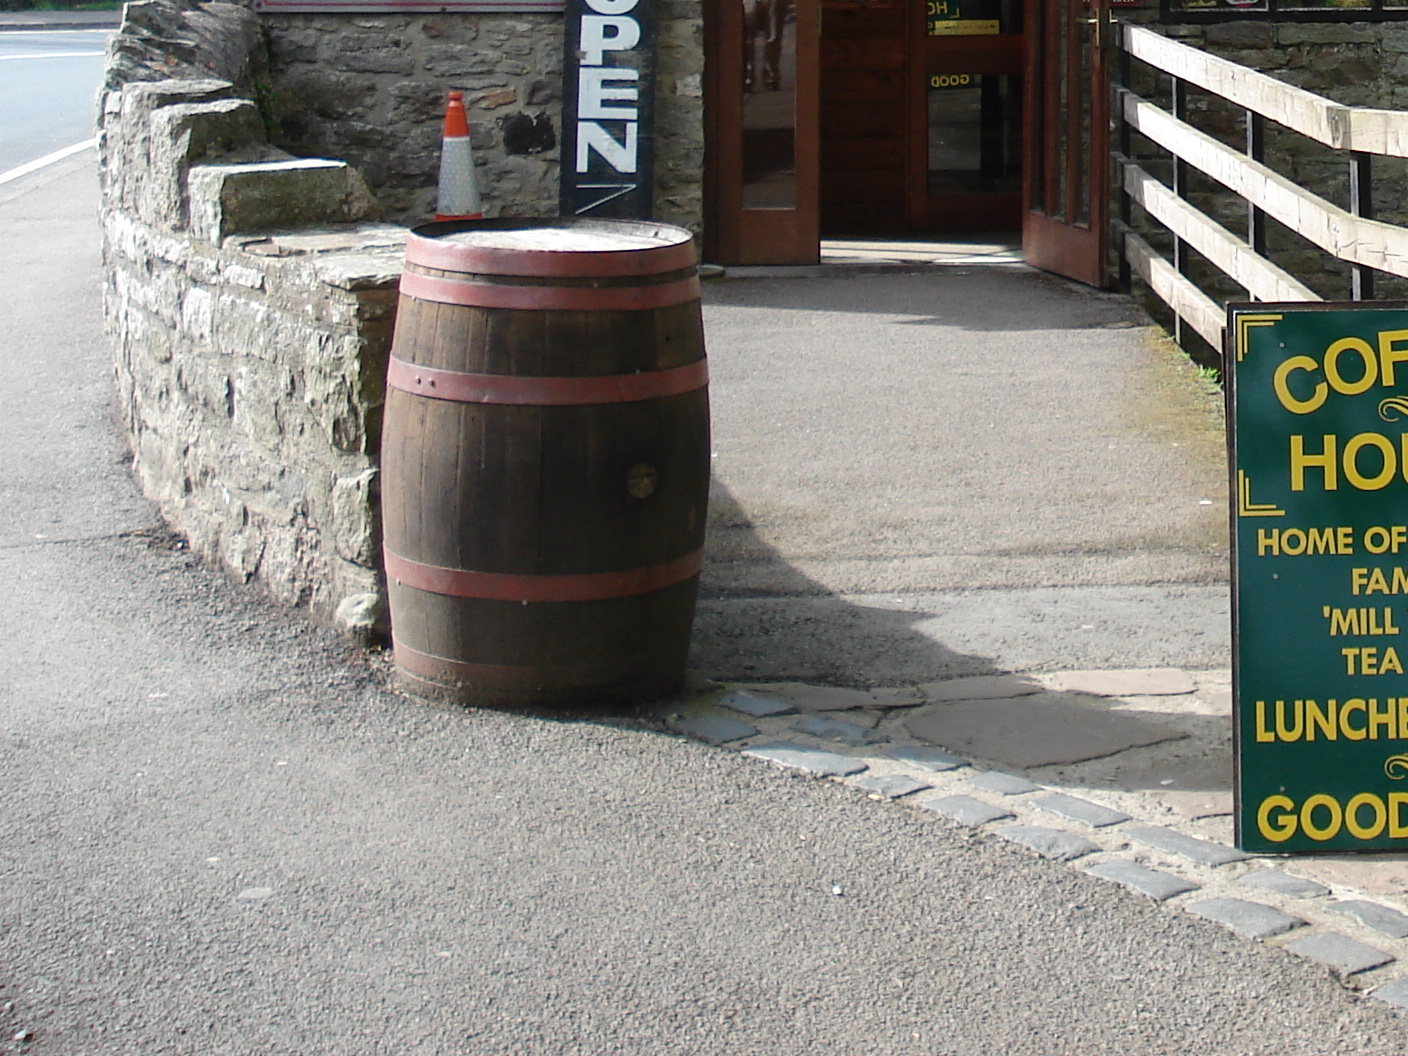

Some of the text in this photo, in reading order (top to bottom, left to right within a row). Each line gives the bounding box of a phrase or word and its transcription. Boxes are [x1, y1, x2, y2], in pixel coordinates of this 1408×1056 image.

[1257, 527, 1353, 556] HOME
[1364, 526, 1407, 554] OF
[1323, 605, 1400, 636] 'MILL
[1342, 646, 1404, 676] TEA
